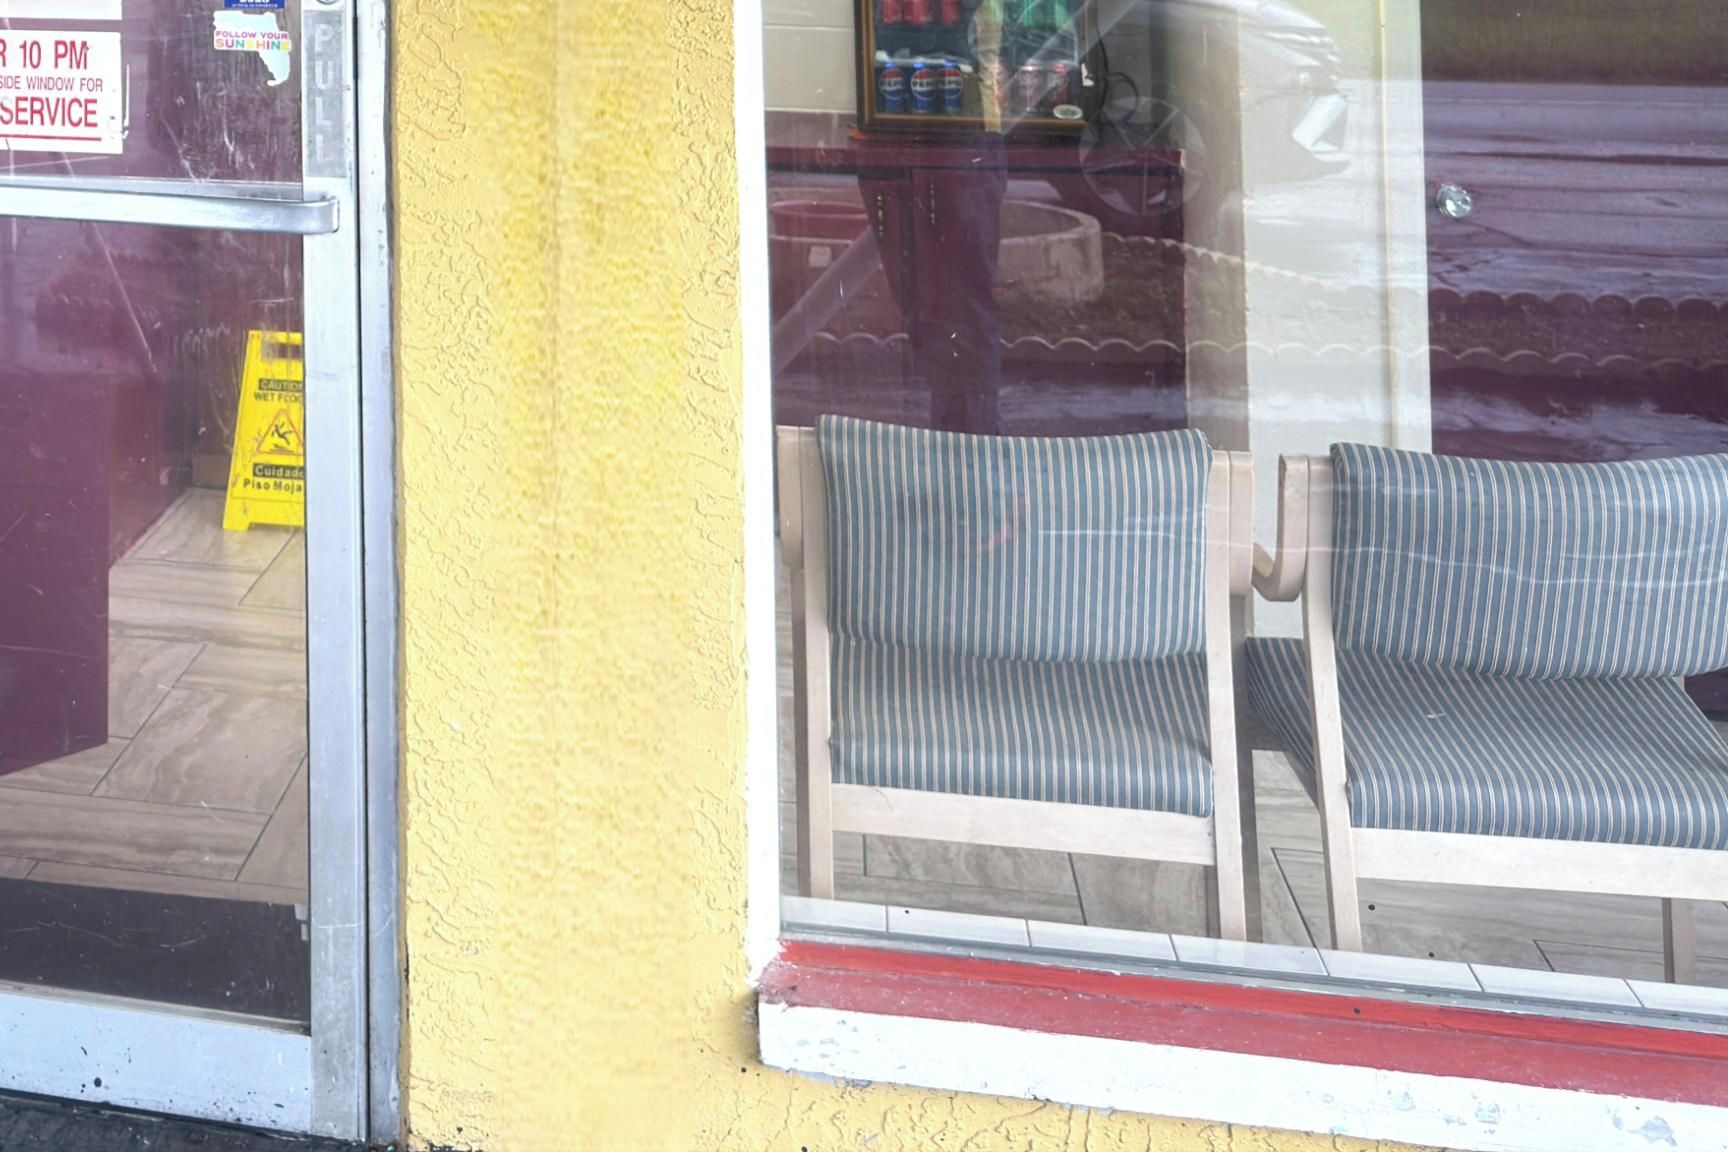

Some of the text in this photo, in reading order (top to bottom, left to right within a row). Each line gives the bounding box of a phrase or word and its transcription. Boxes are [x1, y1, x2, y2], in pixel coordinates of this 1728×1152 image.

[215, 30, 289, 40] FOLLOW YOUR
[215, 38, 290, 52] SUNSHINE
[19, 40, 42, 68] 10
[53, 40, 89, 70] PM
[26, 77, 74, 91] WINDOW
[79, 78, 103, 93] FOR
[0, 96, 98, 128] SERVICE
[253, 392, 275, 402] WET
[243, 478, 270, 490] Piso
